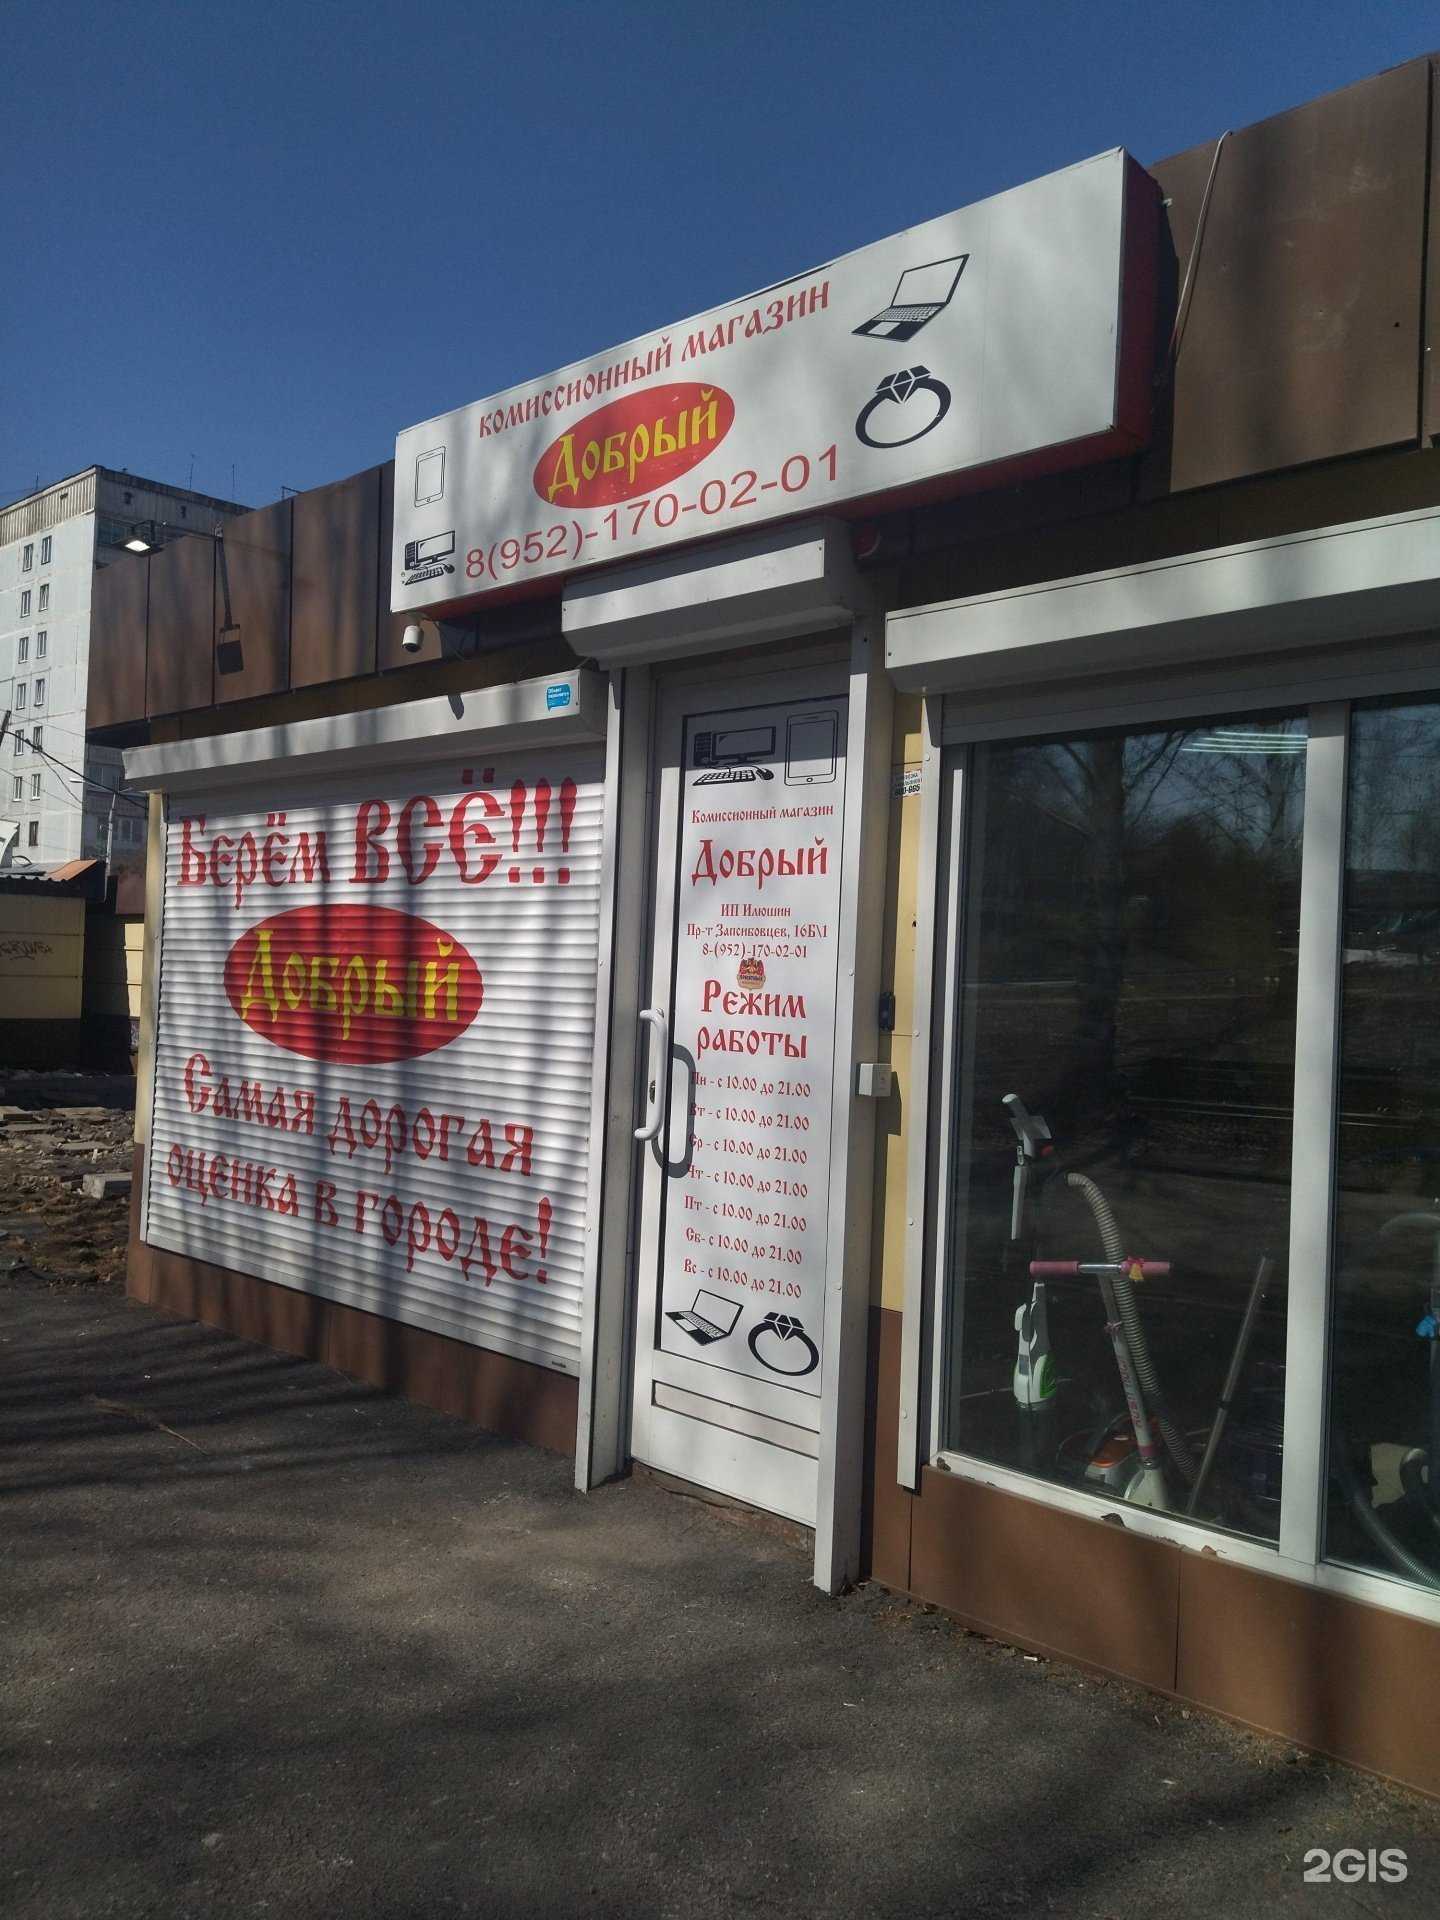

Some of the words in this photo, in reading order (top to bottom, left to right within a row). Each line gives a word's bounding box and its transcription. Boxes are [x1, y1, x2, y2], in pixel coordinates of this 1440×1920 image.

[547, 389, 719, 504] Добрый
[466, 443, 839, 579] 8(952)-170-02-01
[692, 806, 776, 824] Комиссионный
[779, 804, 834, 819] магазин
[176, 813, 331, 911] Берём
[348, 768, 577, 885] ВСЁ!!!
[691, 836, 828, 890] Добрый
[721, 904, 738, 917] ИП
[742, 904, 791, 917] Илюшин
[687, 923, 713, 939] Пр-т
[715, 923, 790, 939] Запсибовцев,
[794, 923, 828, 938] 16Б\1
[702, 943, 807, 959] 8-(952)-170-02-01
[240, 929, 461, 1041] Добрый
[701, 980, 806, 1018] Режим
[697, 1026, 807, 1060] работы
[717, 1078, 722, 1087] с
[726, 1075, 757, 1091] 10.00
[760, 1083, 774, 1095] до
[778, 1080, 811, 1097] 21.00
[184, 1053, 316, 1136] Самая
[327, 1096, 534, 1176] дорогая
[716, 1109, 721, 1119] с
[725, 1107, 756, 1123] 10.00
[759, 1115, 773, 1128] до
[777, 1113, 809, 1131] 21.00
[714, 1140, 719, 1151] с
[723, 1139, 753, 1156] 10.00
[757, 1148, 771, 1160] до
[774, 1146, 807, 1164] 21.00
[714, 1172, 719, 1182] с
[724, 1171, 754, 1188] 10.00
[757, 1180, 771, 1193] до
[775, 1179, 808, 1198] 21.00
[167, 1142, 299, 1217] оценка
[314, 1179, 339, 1227] в
[355, 1195, 552, 1287] городе!
[713, 1204, 718, 1214] с
[722, 1203, 752, 1221] 10.00
[756, 1214, 769, 1226] до
[774, 1212, 806, 1232] 21.00
[709, 1235, 714, 1246] с
[718, 1234, 748, 1253] 10.00
[752, 1245, 765, 1259] до
[769, 1245, 802, 1265] 21.00
[708, 1267, 713, 1278] с
[718, 1266, 747, 1286] 10.00
[751, 1279, 765, 1291] до
[769, 1278, 801, 1298] 21.00
